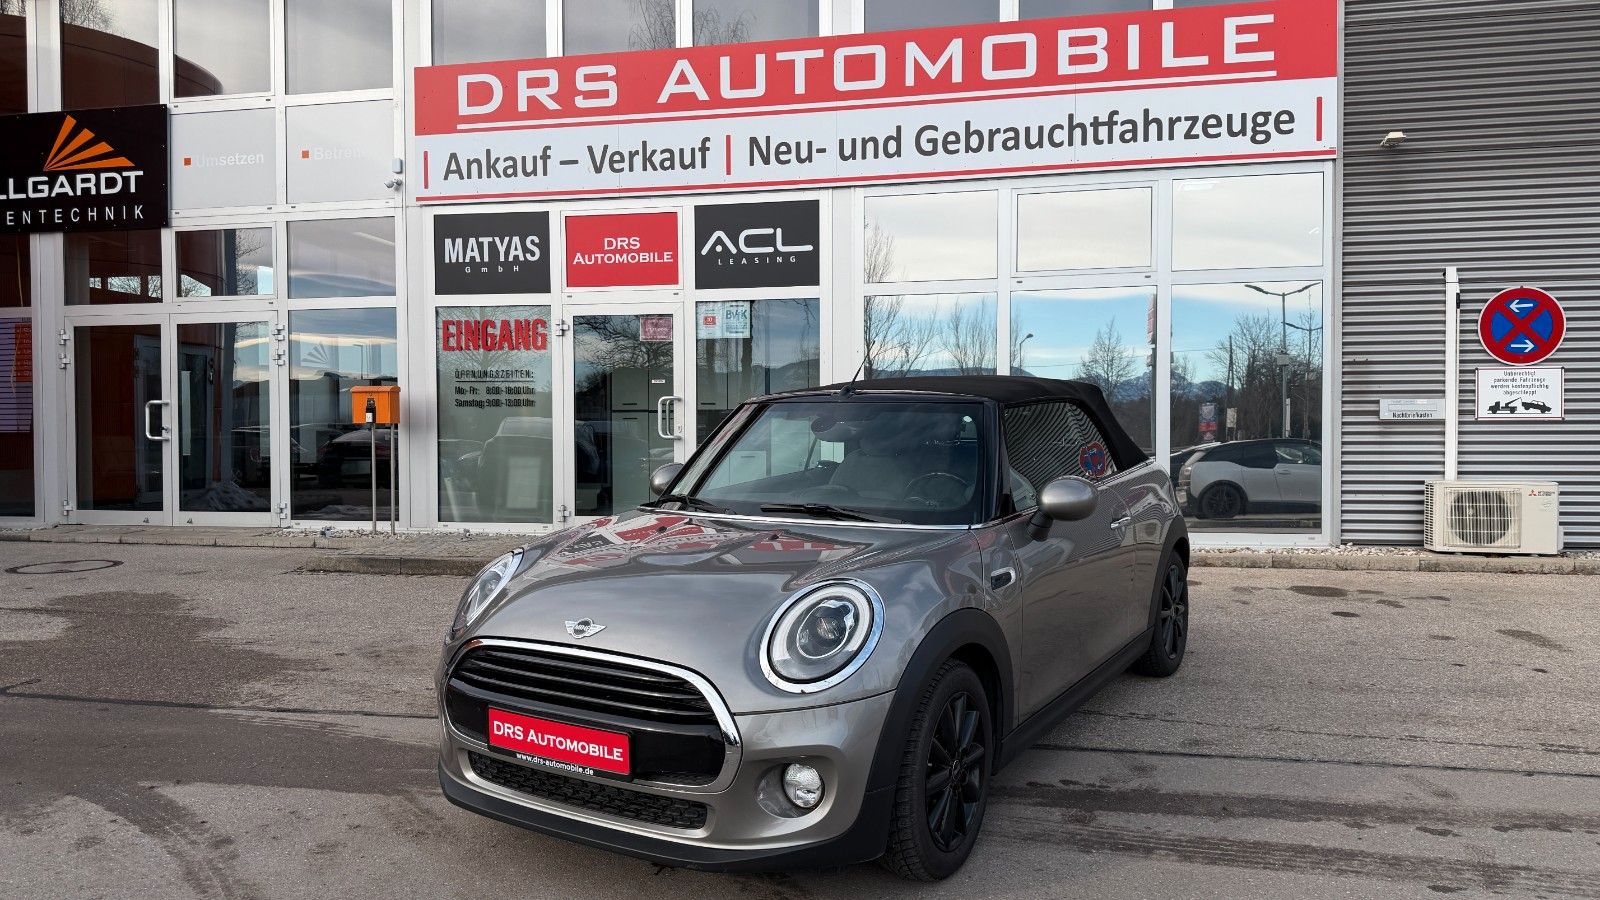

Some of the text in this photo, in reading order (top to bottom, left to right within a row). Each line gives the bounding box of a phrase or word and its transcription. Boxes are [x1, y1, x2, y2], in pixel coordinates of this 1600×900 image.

[458, 14, 1275, 116] DRS AUTOMOBILE
[443, 145, 551, 181] Ankauf
[586, 137, 711, 174] Verkauf
[748, 135, 827, 167] Neu-
[838, 125, 902, 162] und
[914, 108, 1296, 157] Gebrauchtfahrzeuge
[195, 152, 264, 168] Umsetzen
[6, 205, 144, 225] ENTECHNIK
[444, 235, 541, 263] MATYAS
[604, 237, 640, 250] DRS
[701, 228, 813, 255] ACL
[573, 252, 673, 265] AUTOMOBILE
[718, 256, 796, 265] LEASING
[441, 318, 548, 352] EINGANG
[523, 386, 534, 396] Uhr
[523, 398, 535, 409] Uhr
[493, 720, 623, 762] DRS AUTOMOBILE
[516, 752, 594, 776] www.drs-automobile.de
